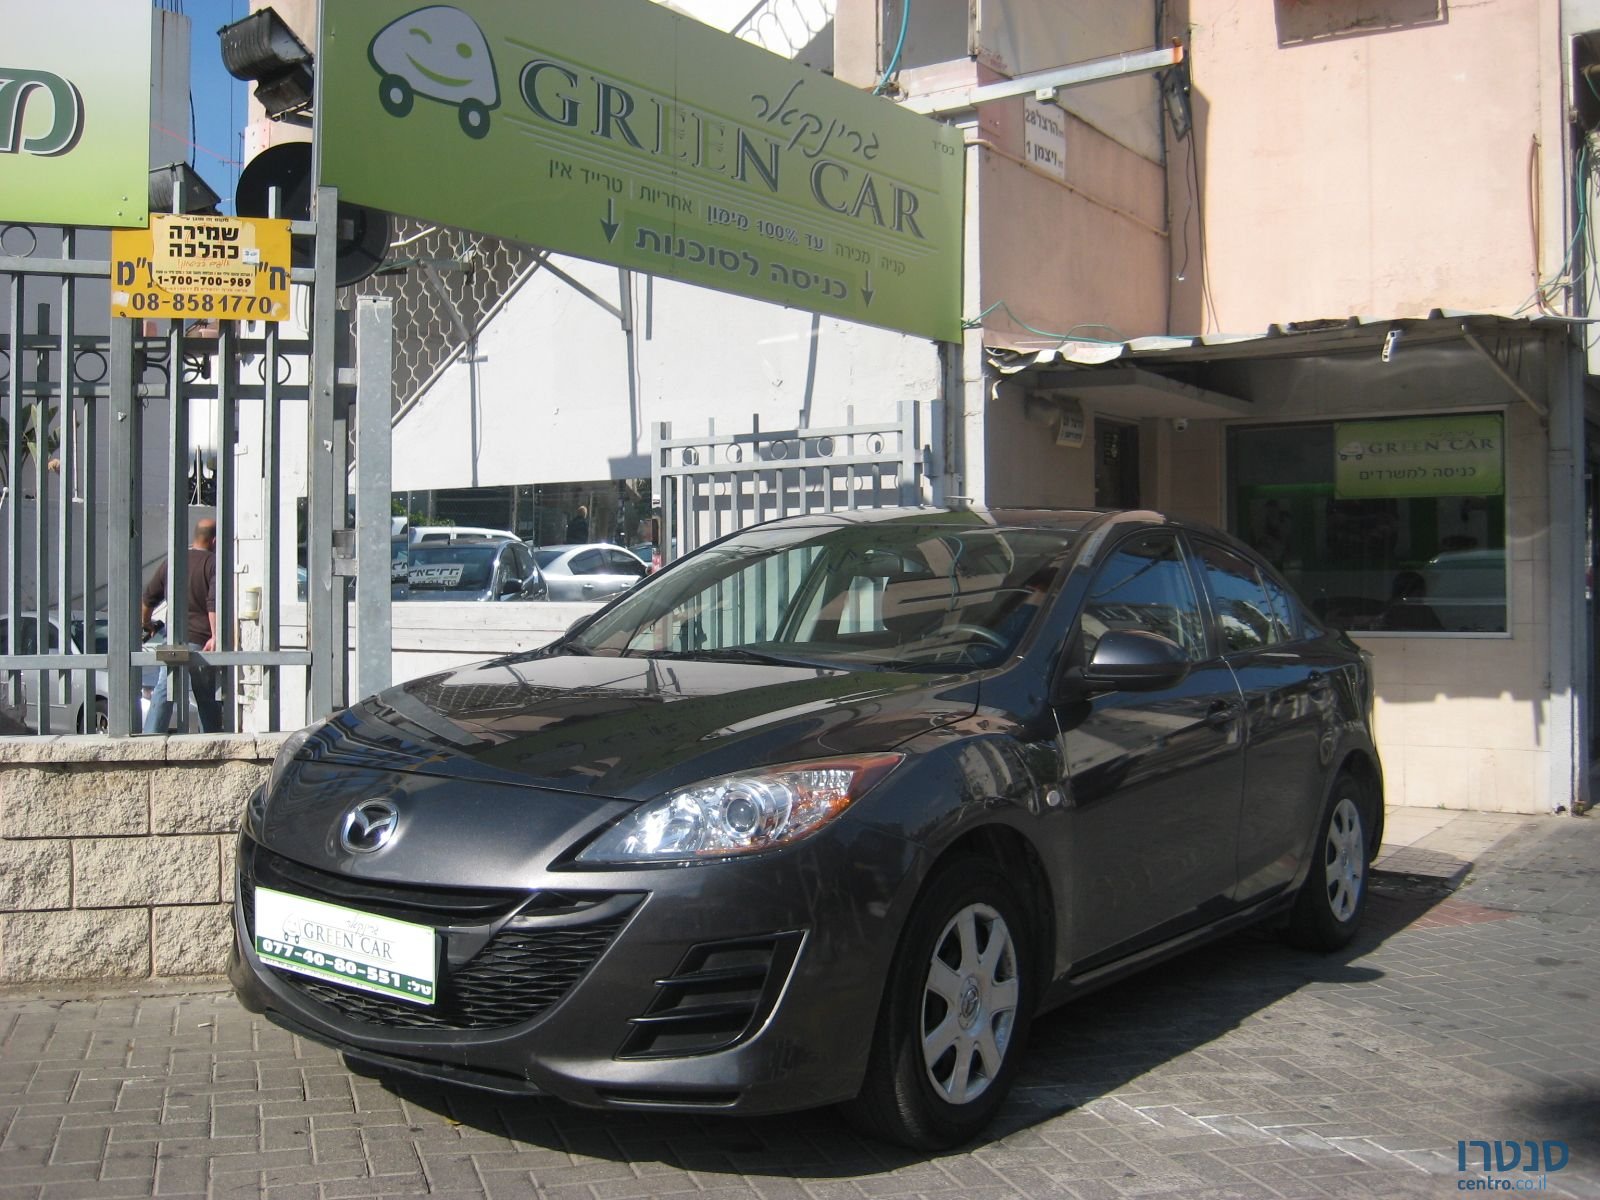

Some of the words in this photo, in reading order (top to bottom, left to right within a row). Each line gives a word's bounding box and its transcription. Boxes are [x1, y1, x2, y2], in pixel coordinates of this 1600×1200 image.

[751, 79, 880, 160] גרינקאר
[519, 59, 782, 192] GREEN
[810, 159, 927, 240] CAR
[549, 159, 572, 180] אין
[580, 167, 623, 193] טרייד
[640, 185, 693, 213] אחריות
[707, 205, 749, 232] מימון
[169, 225, 239, 241] שמירה
[757, 219, 800, 247] 100%
[805, 232, 824, 251] עד
[169, 241, 239, 259] כהלכה
[635, 228, 759, 276] לסוכנות
[836, 243, 870, 264] מכירה
[881, 256, 905, 276] קניה
[158, 275, 251, 287] 1-700-700-989
[770, 262, 848, 299] כניסה
[132, 292, 272, 314] 08-8581770
[1448, 438, 1494, 451] CAR
[1432, 466, 1477, 478] כניסה
[303, 922, 353, 948] GREEN
[360, 937, 392, 960] CAR
[262, 938, 401, 988] 077-40-80-551
